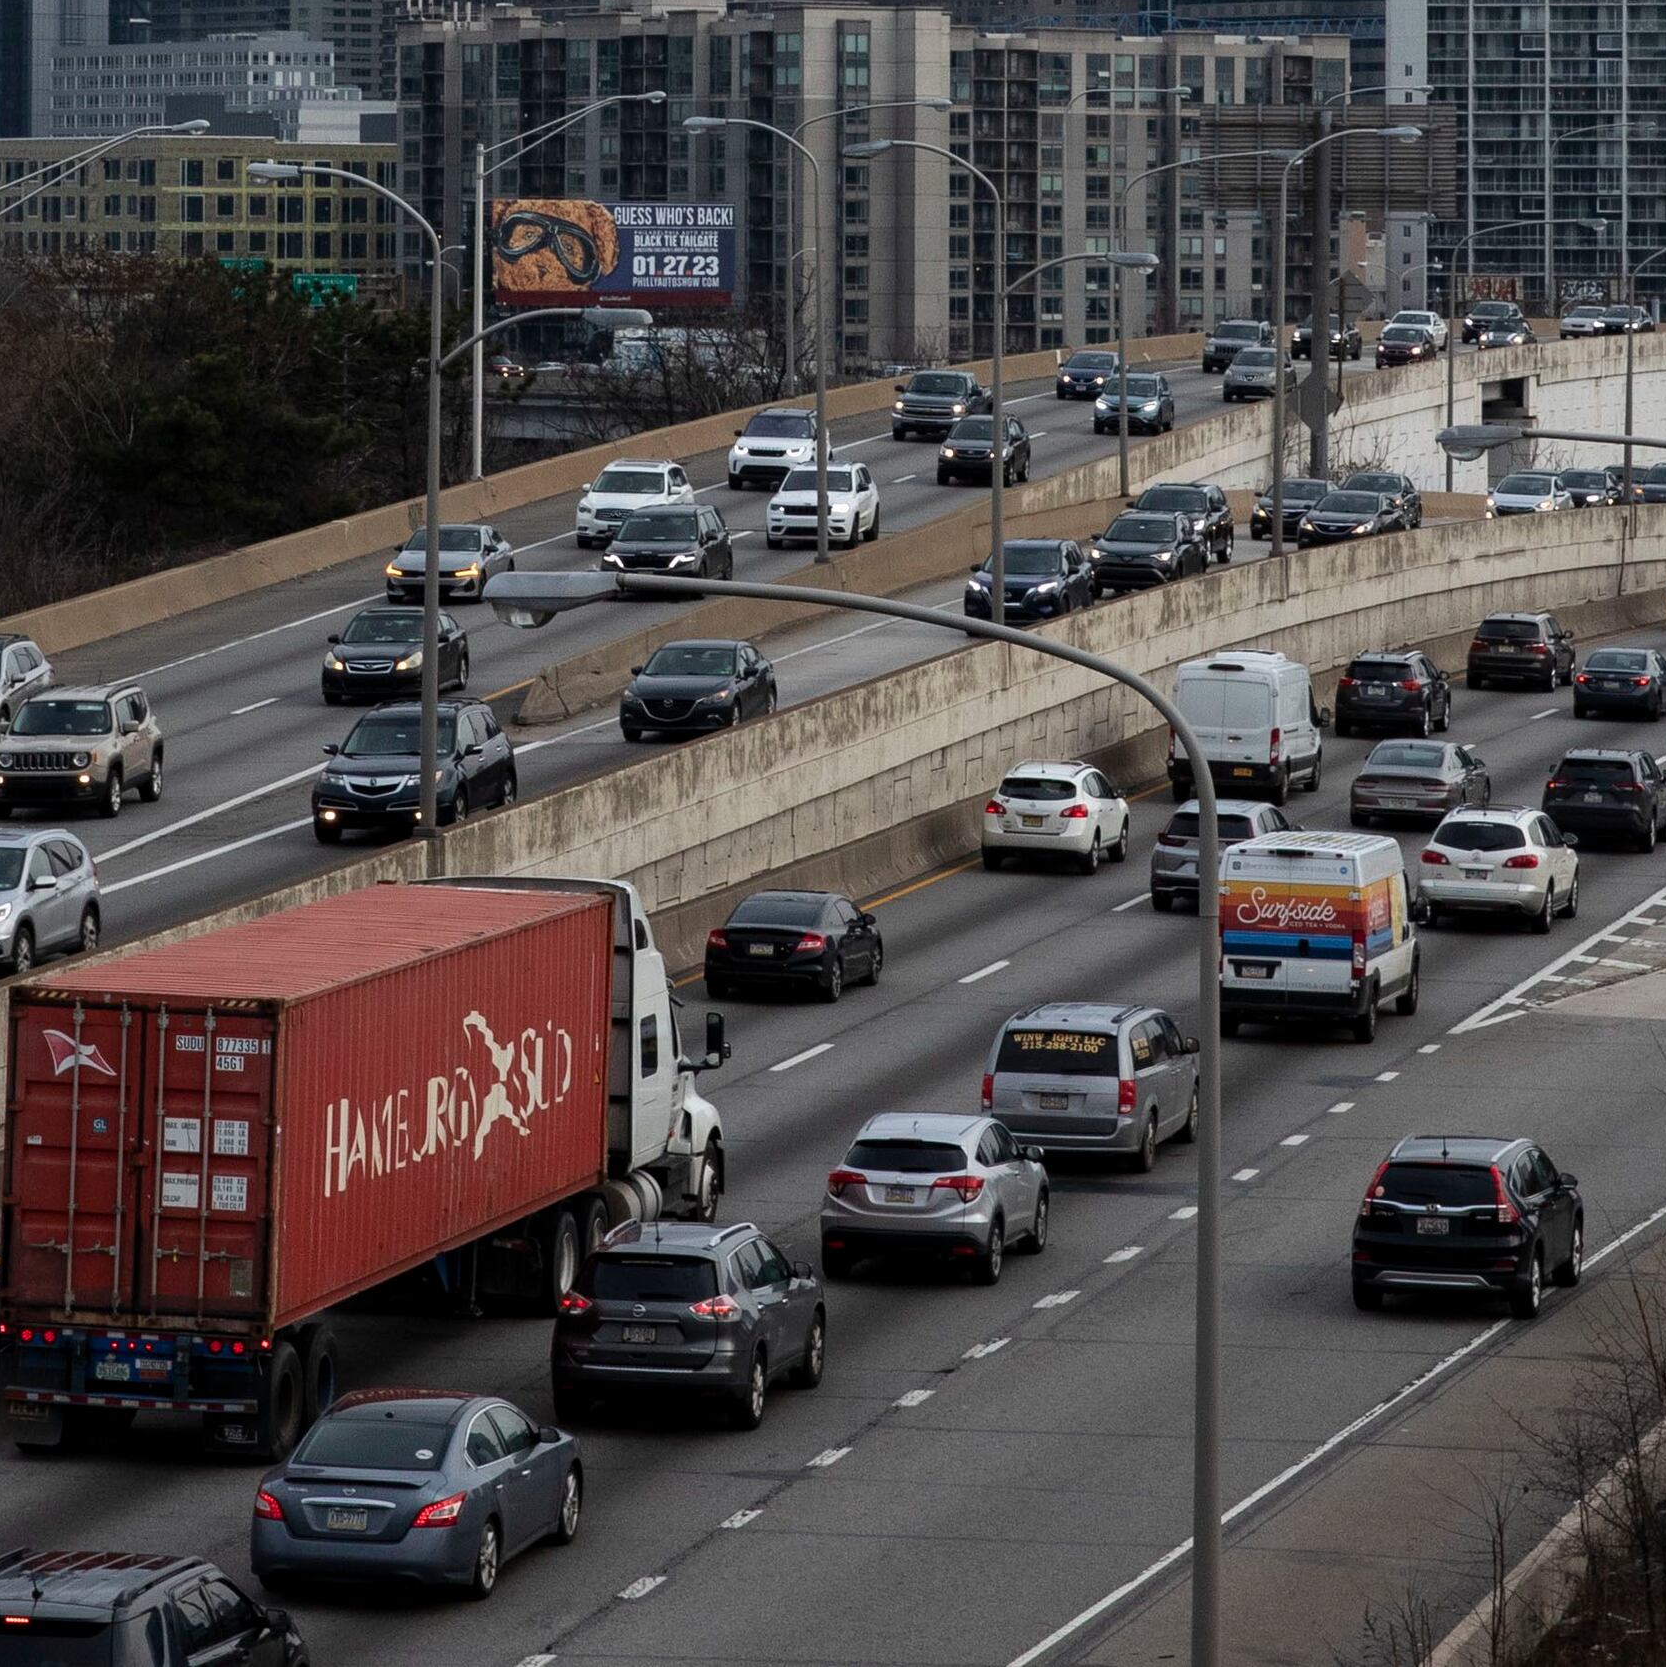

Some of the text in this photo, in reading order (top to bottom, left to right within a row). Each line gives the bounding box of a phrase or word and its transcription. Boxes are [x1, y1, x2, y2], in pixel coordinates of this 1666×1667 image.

[615, 207, 733, 225] GUESS WHO'S BACK!
[634, 235, 718, 247] BLACK TIE TAILGATE
[633, 255, 719, 275] 01.27.23
[1237, 887, 1337, 927] Surfside
[177, 1036, 204, 1050] SUDU
[217, 1039, 257, 1052] 877335
[1021, 1041, 1099, 1054] 215-288-2100
[1084, 1035, 1107, 1047] LLC
[217, 1057, 243, 1070] 45G1
[93, 1119, 108, 1129] GL
